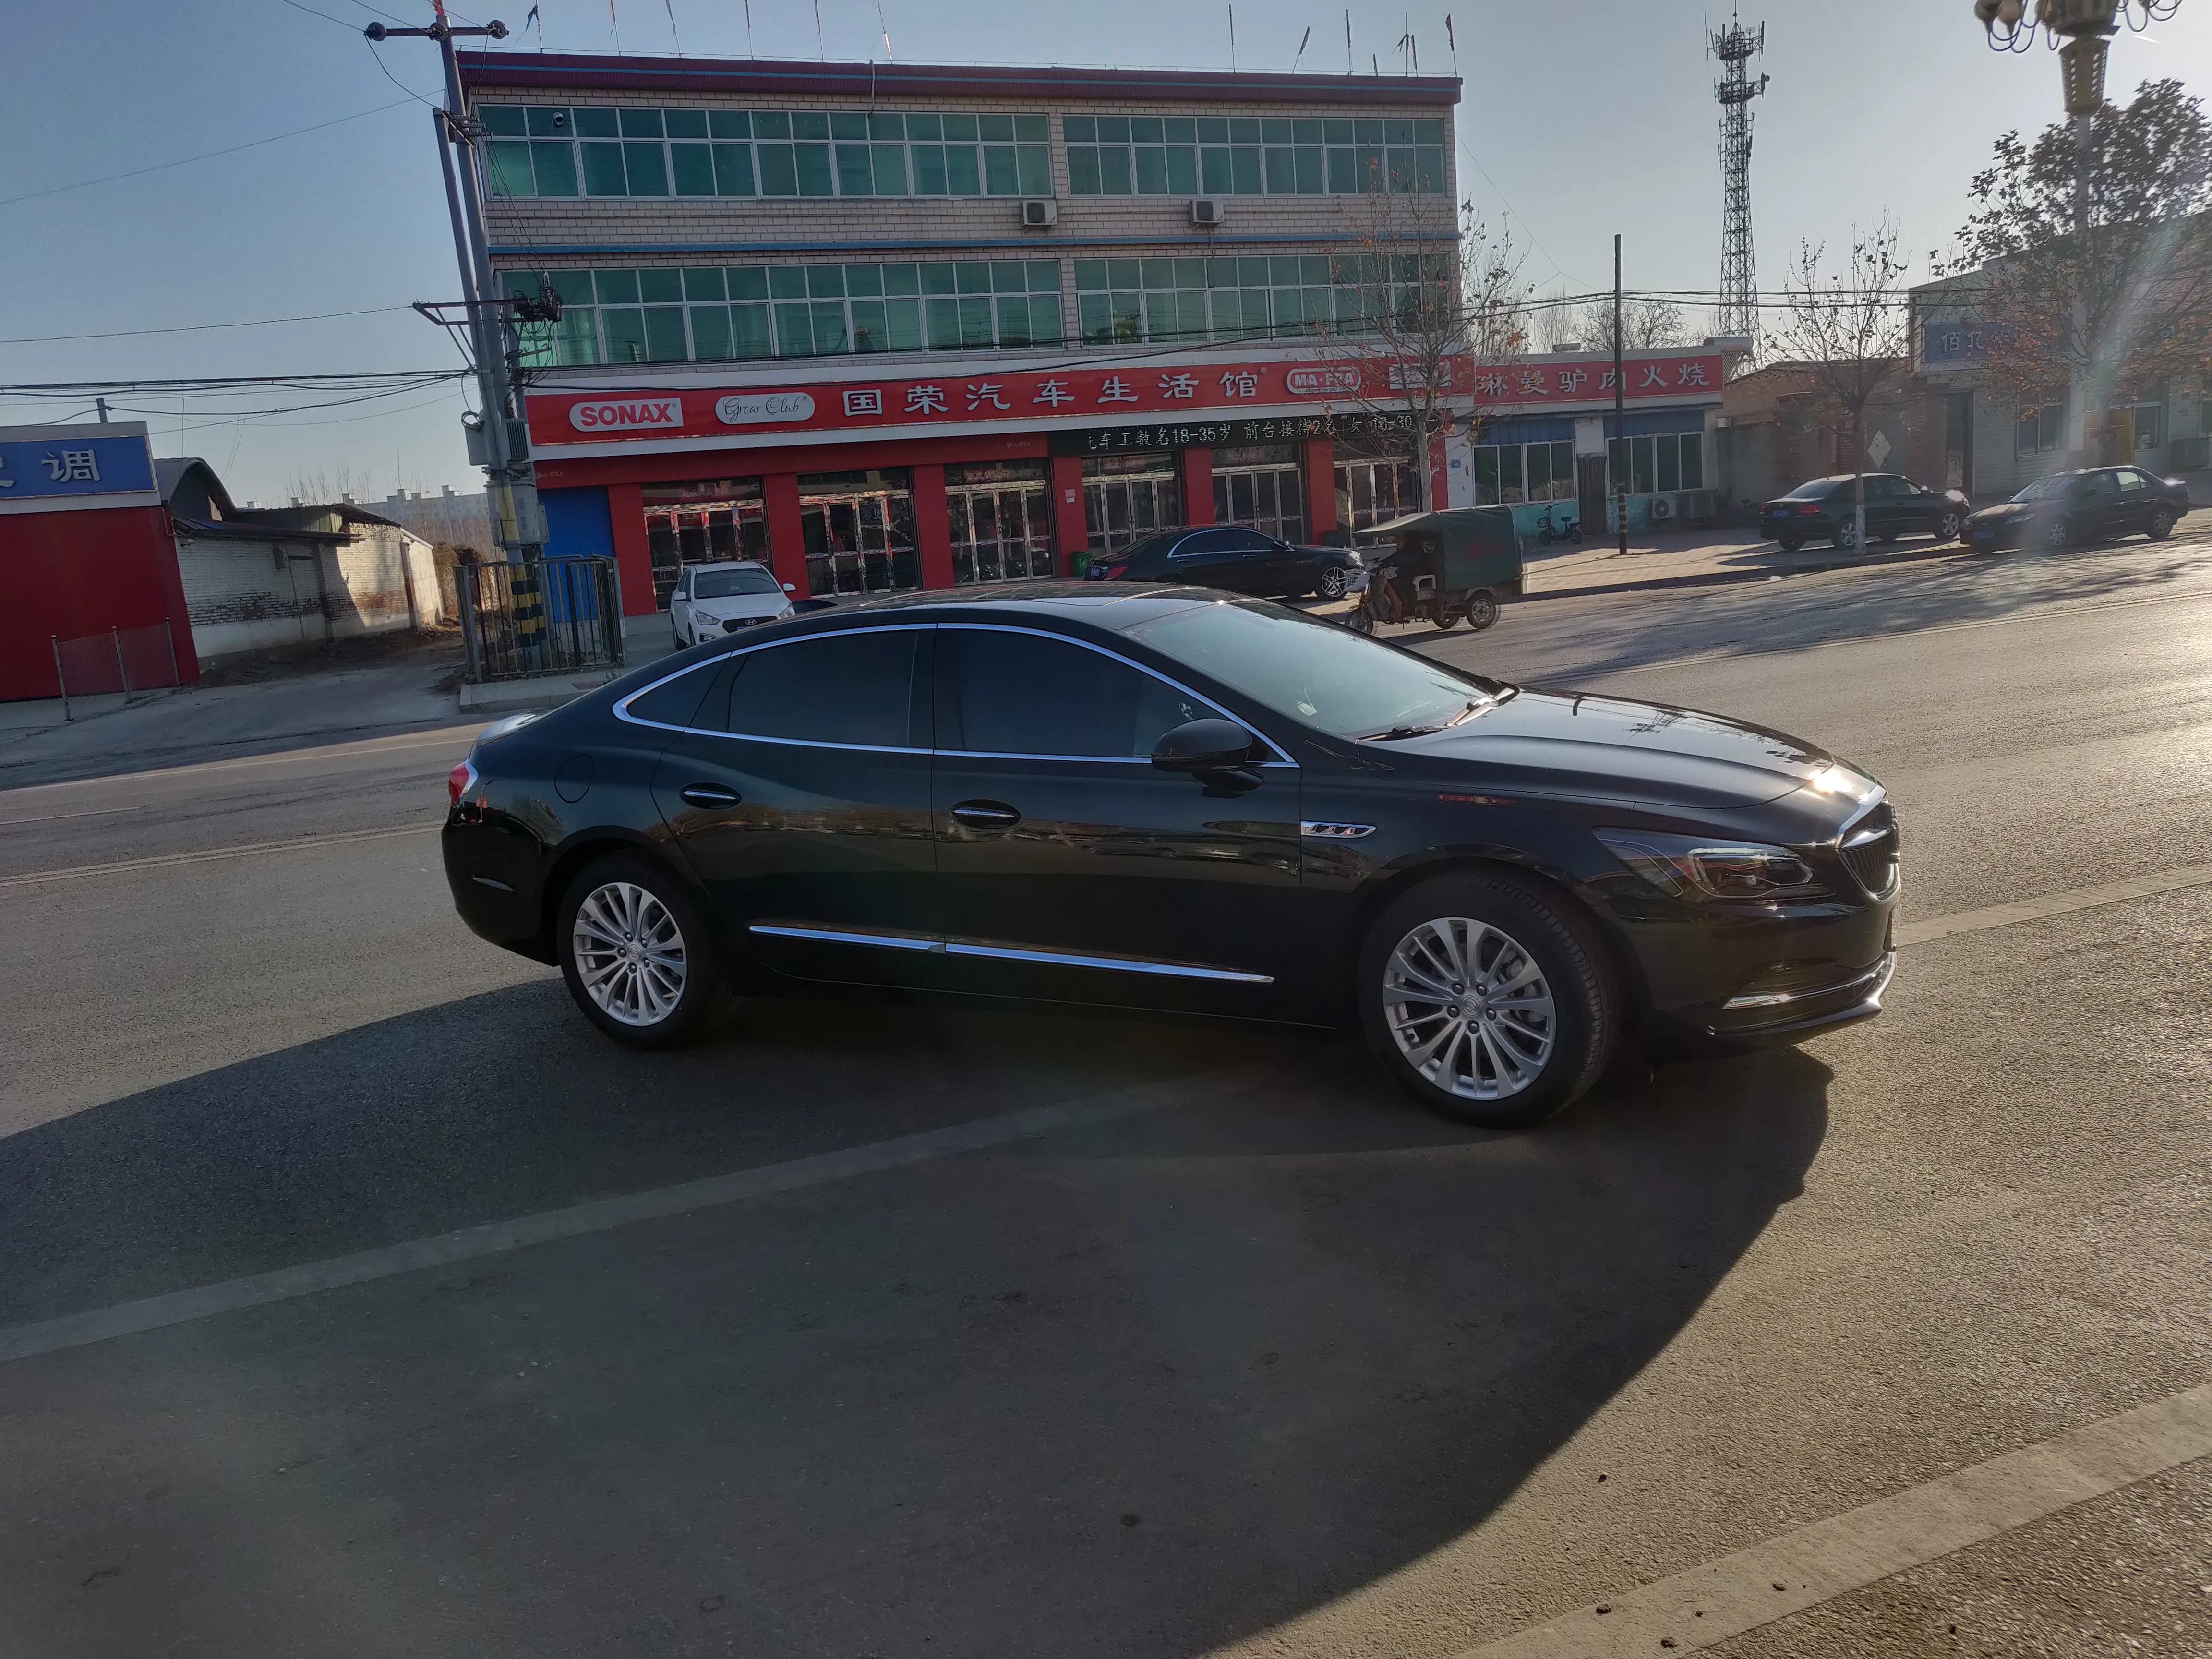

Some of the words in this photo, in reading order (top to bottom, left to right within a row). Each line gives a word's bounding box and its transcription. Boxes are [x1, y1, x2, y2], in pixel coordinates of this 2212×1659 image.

[842, 371, 1259, 417] 国荣汽车生活馆
[580, 403, 673, 427] SONAX
[766, 397, 800, 416] Club
